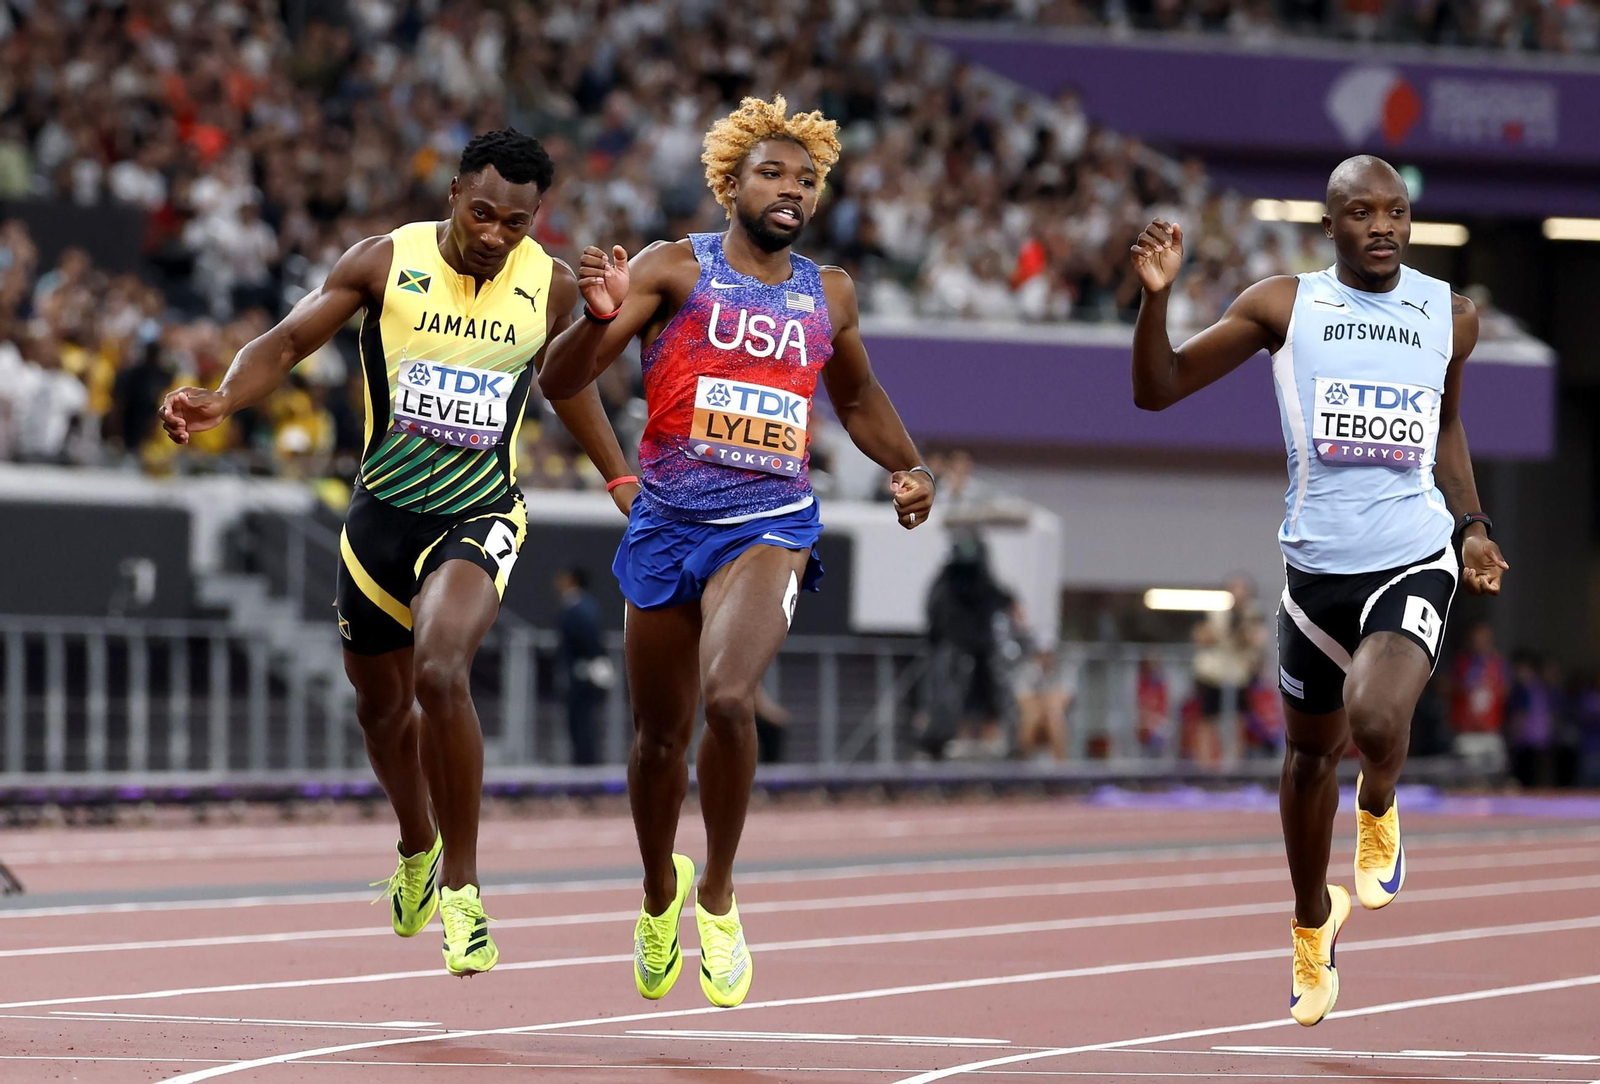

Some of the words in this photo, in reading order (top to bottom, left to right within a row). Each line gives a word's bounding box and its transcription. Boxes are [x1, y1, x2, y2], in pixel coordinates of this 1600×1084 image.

[413, 311, 516, 345] JAMAICA
[708, 302, 808, 366] USA
[1323, 323, 1422, 348] BOTSWANA
[432, 366, 505, 398] TDK
[402, 389, 499, 427] LEVELL
[732, 386, 802, 424] TDK
[1349, 384, 1425, 414] TDK
[706, 413, 797, 452] LYLES
[1320, 412, 1424, 444] TEBOGO
[496, 534, 513, 560] 7
